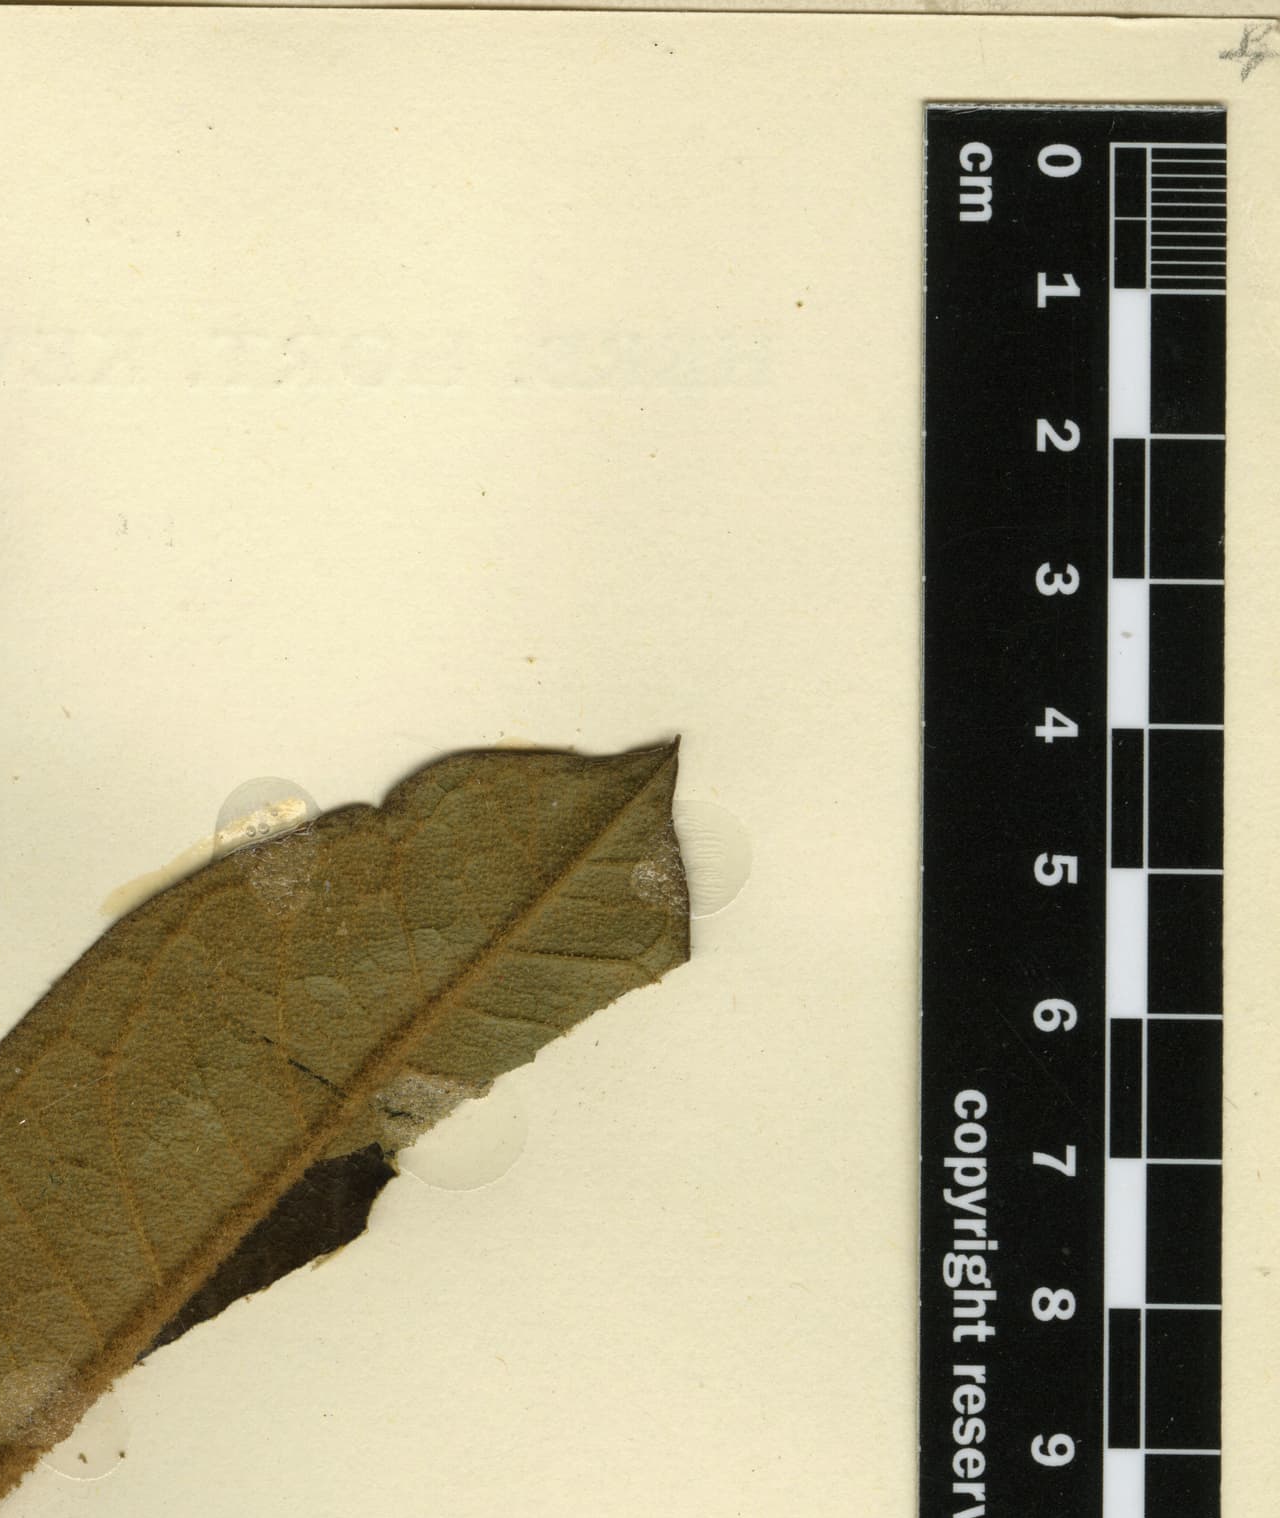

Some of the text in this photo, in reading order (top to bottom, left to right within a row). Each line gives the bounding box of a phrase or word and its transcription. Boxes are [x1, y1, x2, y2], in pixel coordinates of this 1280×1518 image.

[1036, 143, 1082, 178] 0
[958, 141, 993, 222] cm
[1036, 271, 1081, 309] 1
[1036, 418, 1081, 453] 2
[1035, 562, 1081, 597] 3
[1034, 706, 1079, 744] 4
[1033, 852, 1078, 887] 5
[1032, 998, 1078, 1033] 6
[1032, 1144, 1077, 1177] 7
[942, 1089, 999, 1343] copyright
[1031, 1286, 1077, 1322] 8
[1030, 1433, 1076, 1467] 9
